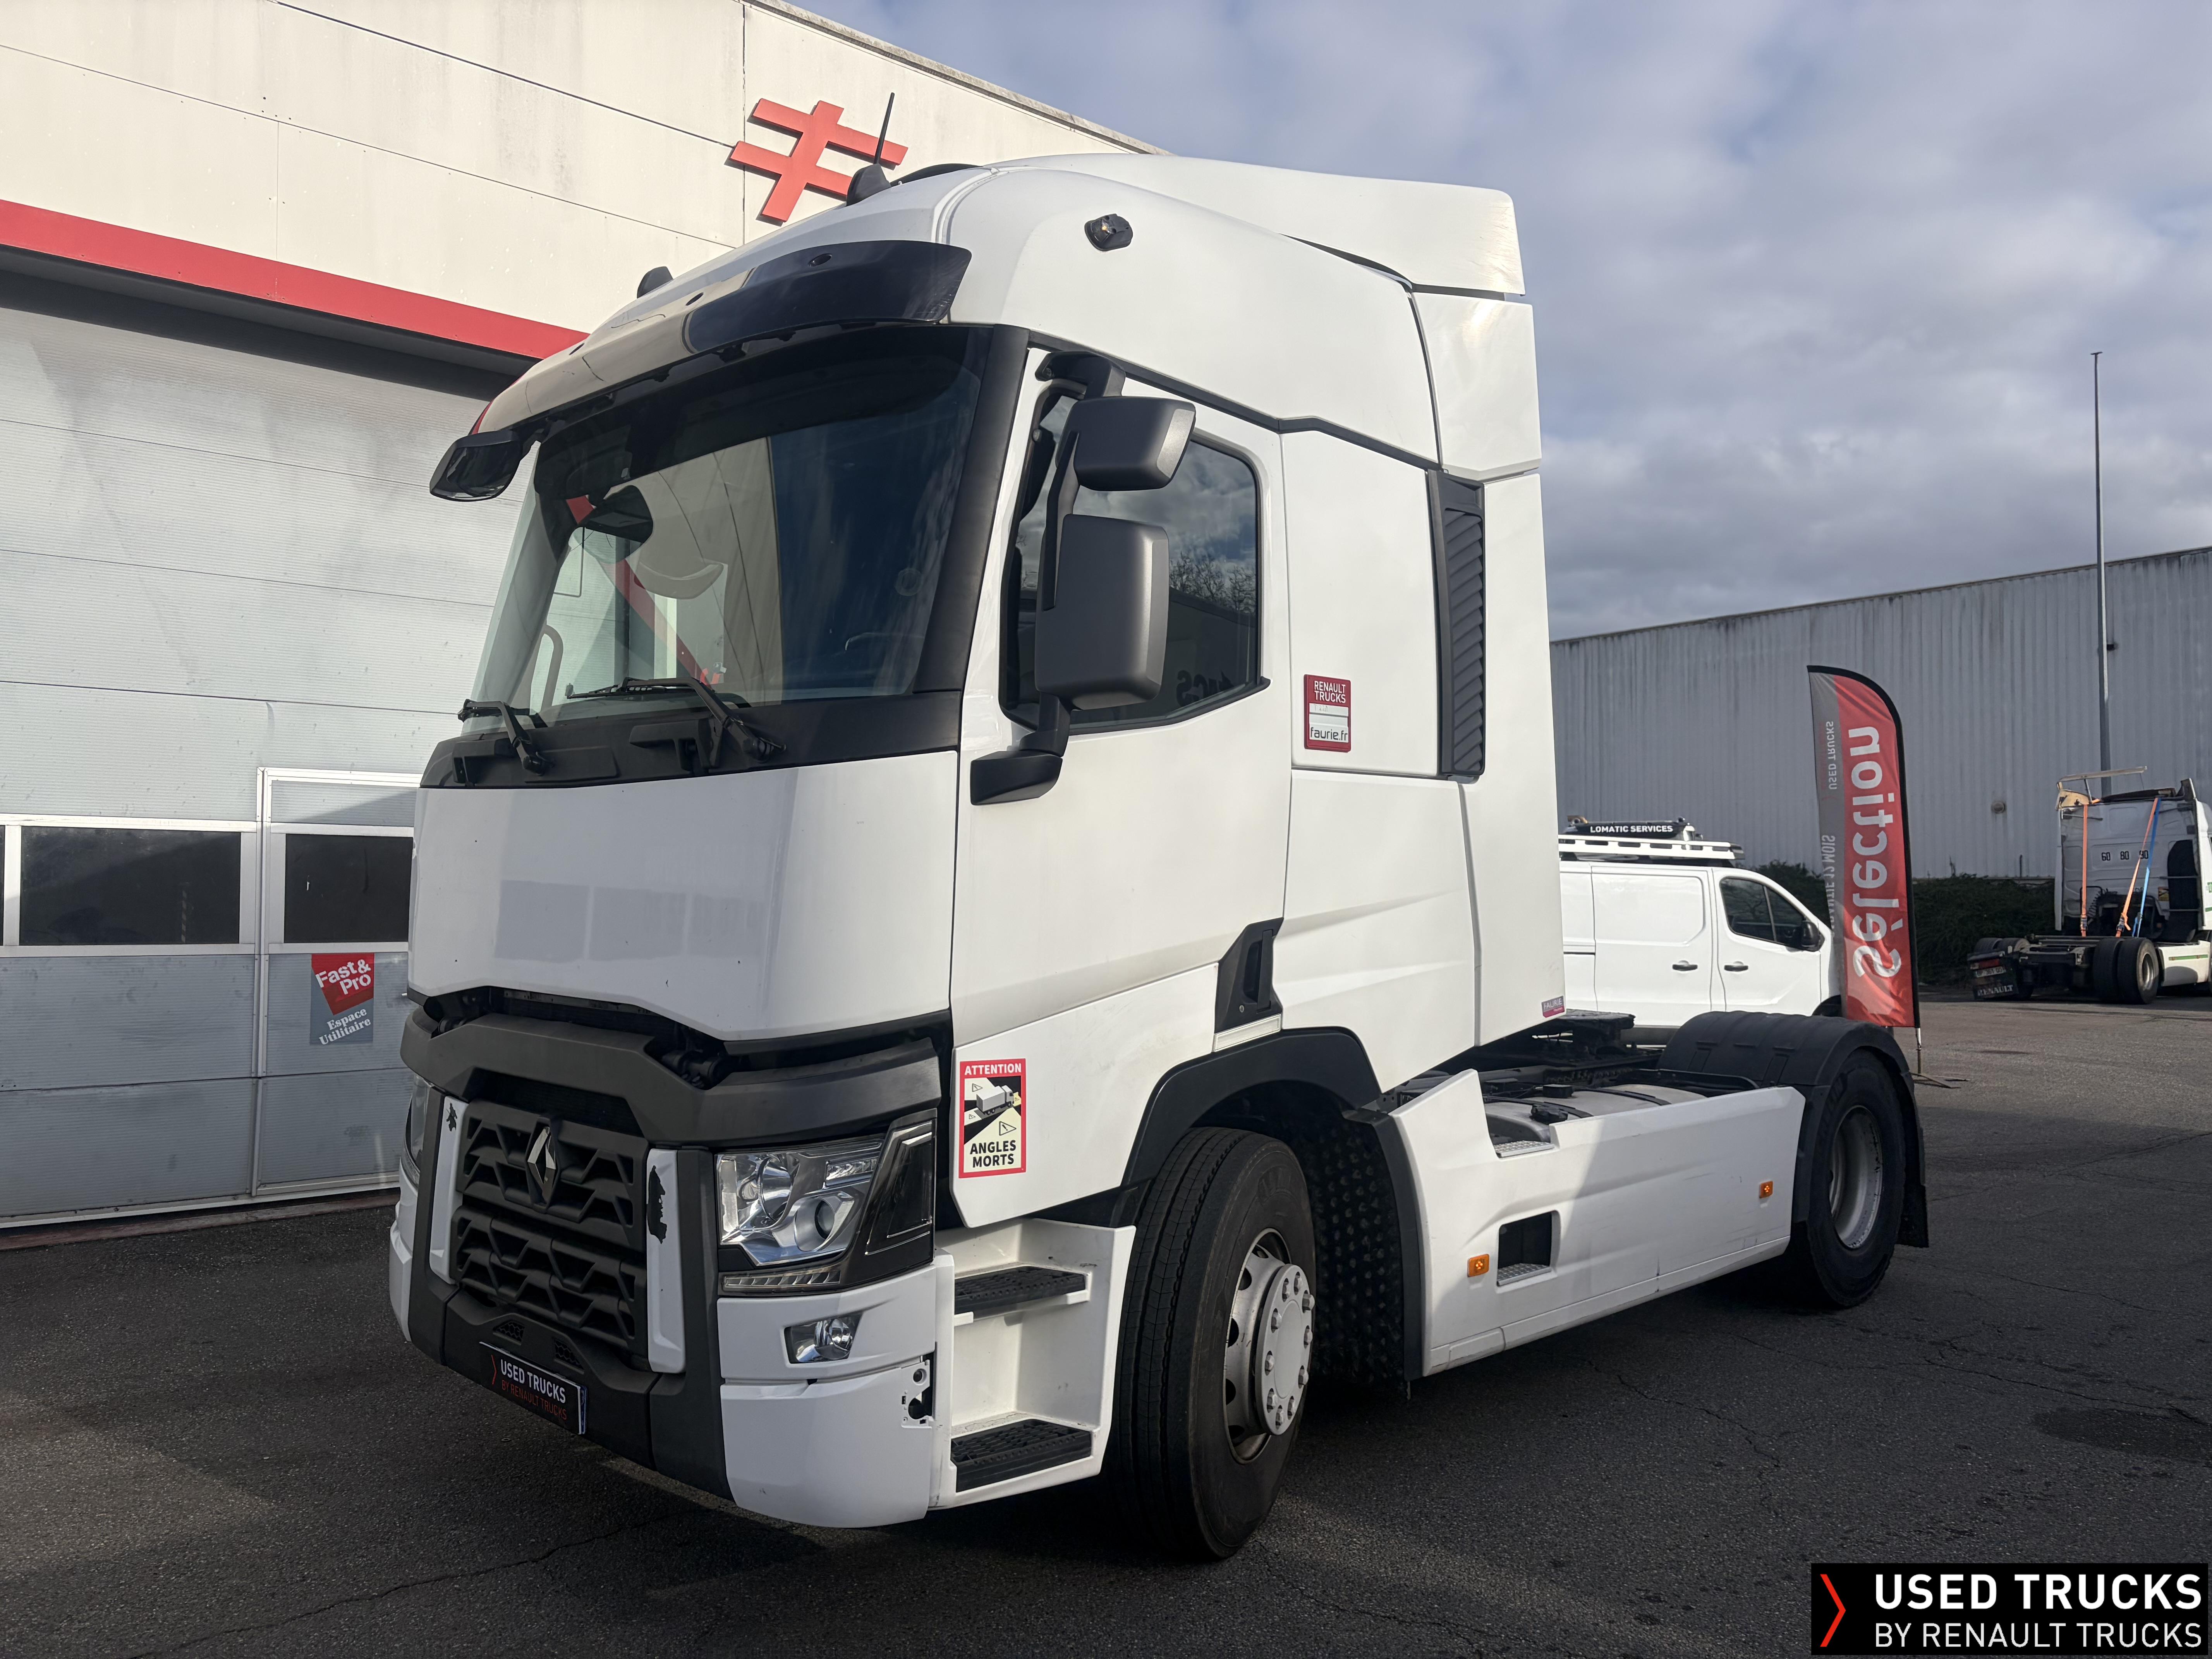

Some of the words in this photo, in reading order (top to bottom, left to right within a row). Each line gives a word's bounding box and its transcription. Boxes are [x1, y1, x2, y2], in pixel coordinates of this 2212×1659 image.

[1314, 680, 1346, 693] RENAULT
[1314, 691, 1346, 703] TRUCKS
[1310, 727, 1348, 740] faurie.fr
[2101, 852, 2111, 861] 60
[2120, 851, 2129, 860] 80
[340, 974, 371, 994] Pro
[1544, 998, 1562, 1010] FAURIE
[327, 1009, 367, 1030] Espace
[319, 1018, 371, 1045] Utilitaire
[964, 1063, 1021, 1075] ATTENTION
[970, 1140, 1016, 1154] ANGLES
[972, 1154, 1014, 1168] MORTS
[501, 1359, 525, 1384] USED
[527, 1372, 565, 1403] TRUCKS
[502, 1379, 510, 1391] BY
[511, 1384, 539, 1406] RENAULT
[541, 1397, 567, 1420] TRUCKS
